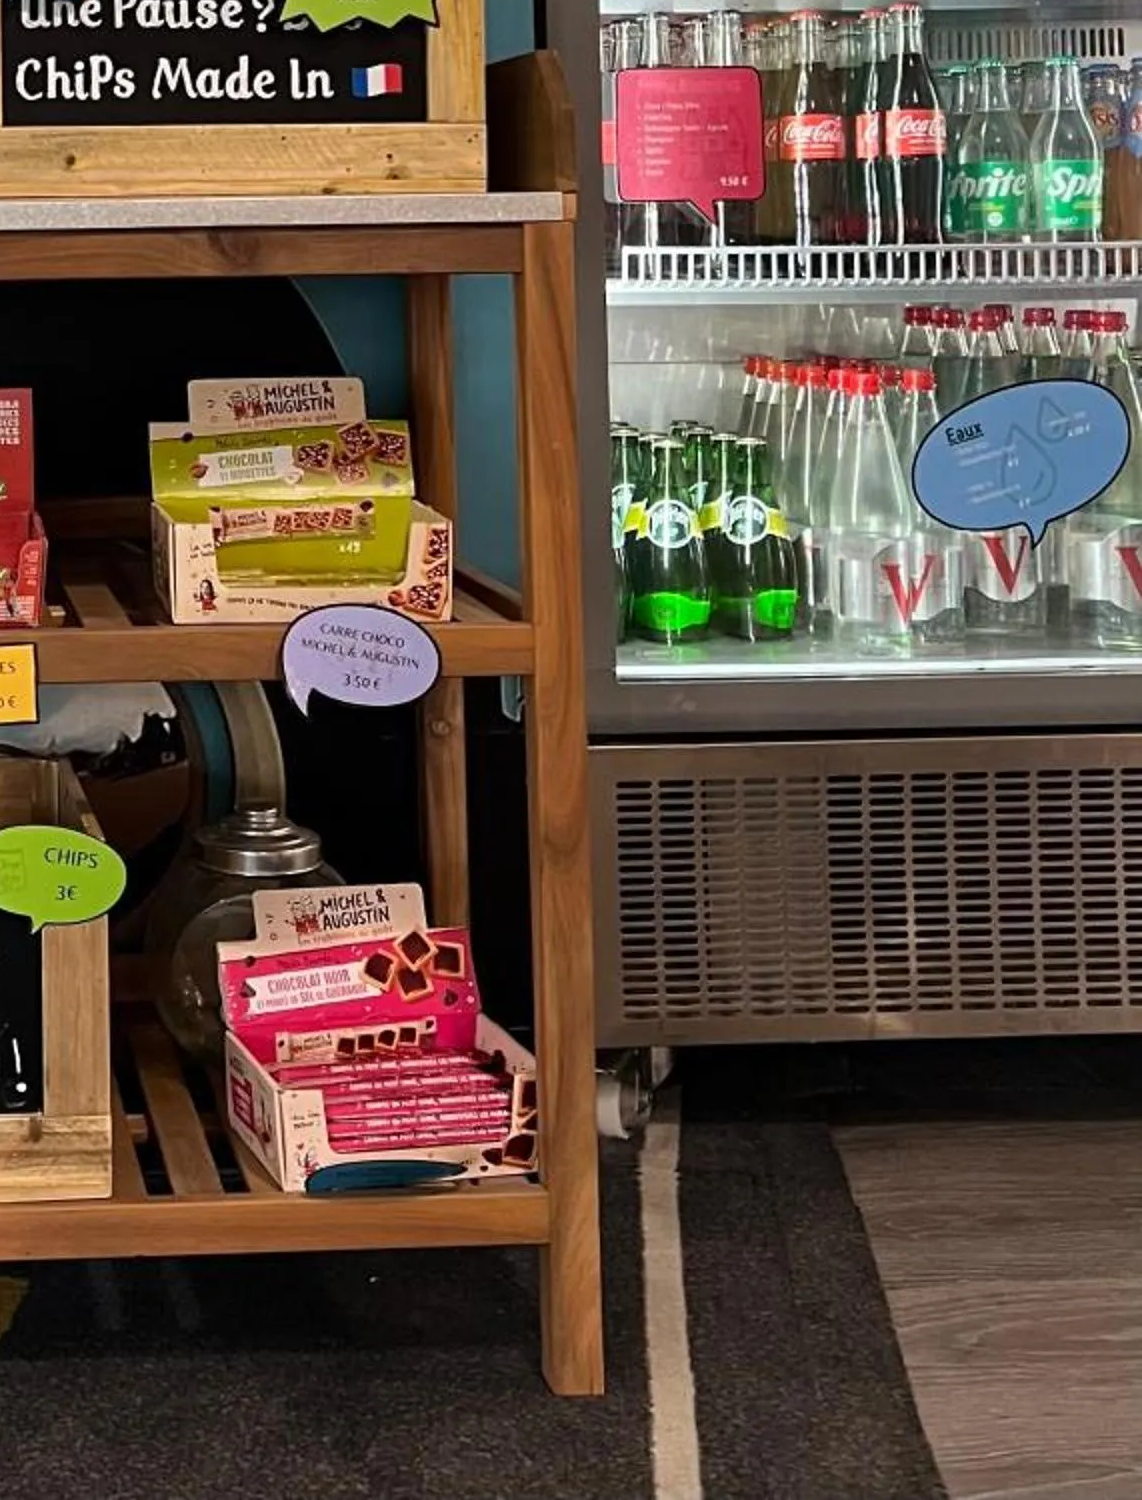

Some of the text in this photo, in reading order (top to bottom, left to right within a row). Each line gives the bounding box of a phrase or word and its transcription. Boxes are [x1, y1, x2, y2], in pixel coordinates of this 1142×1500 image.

[151, 56, 277, 101] Made
[290, 58, 335, 100] In
[263, 380, 333, 400] MICHEL &
[263, 396, 336, 416] AUGUSTIN
[945, 423, 985, 446] Eaux
[319, 622, 406, 648] CARRE CHOCO
[301, 636, 421, 670] MICHEL & AUGUSTIN
[44, 847, 99, 870] CHIPS
[55, 884, 79, 902] 3€
[320, 888, 387, 914] MICHEL &
[322, 906, 391, 931] AUGUSTIN
